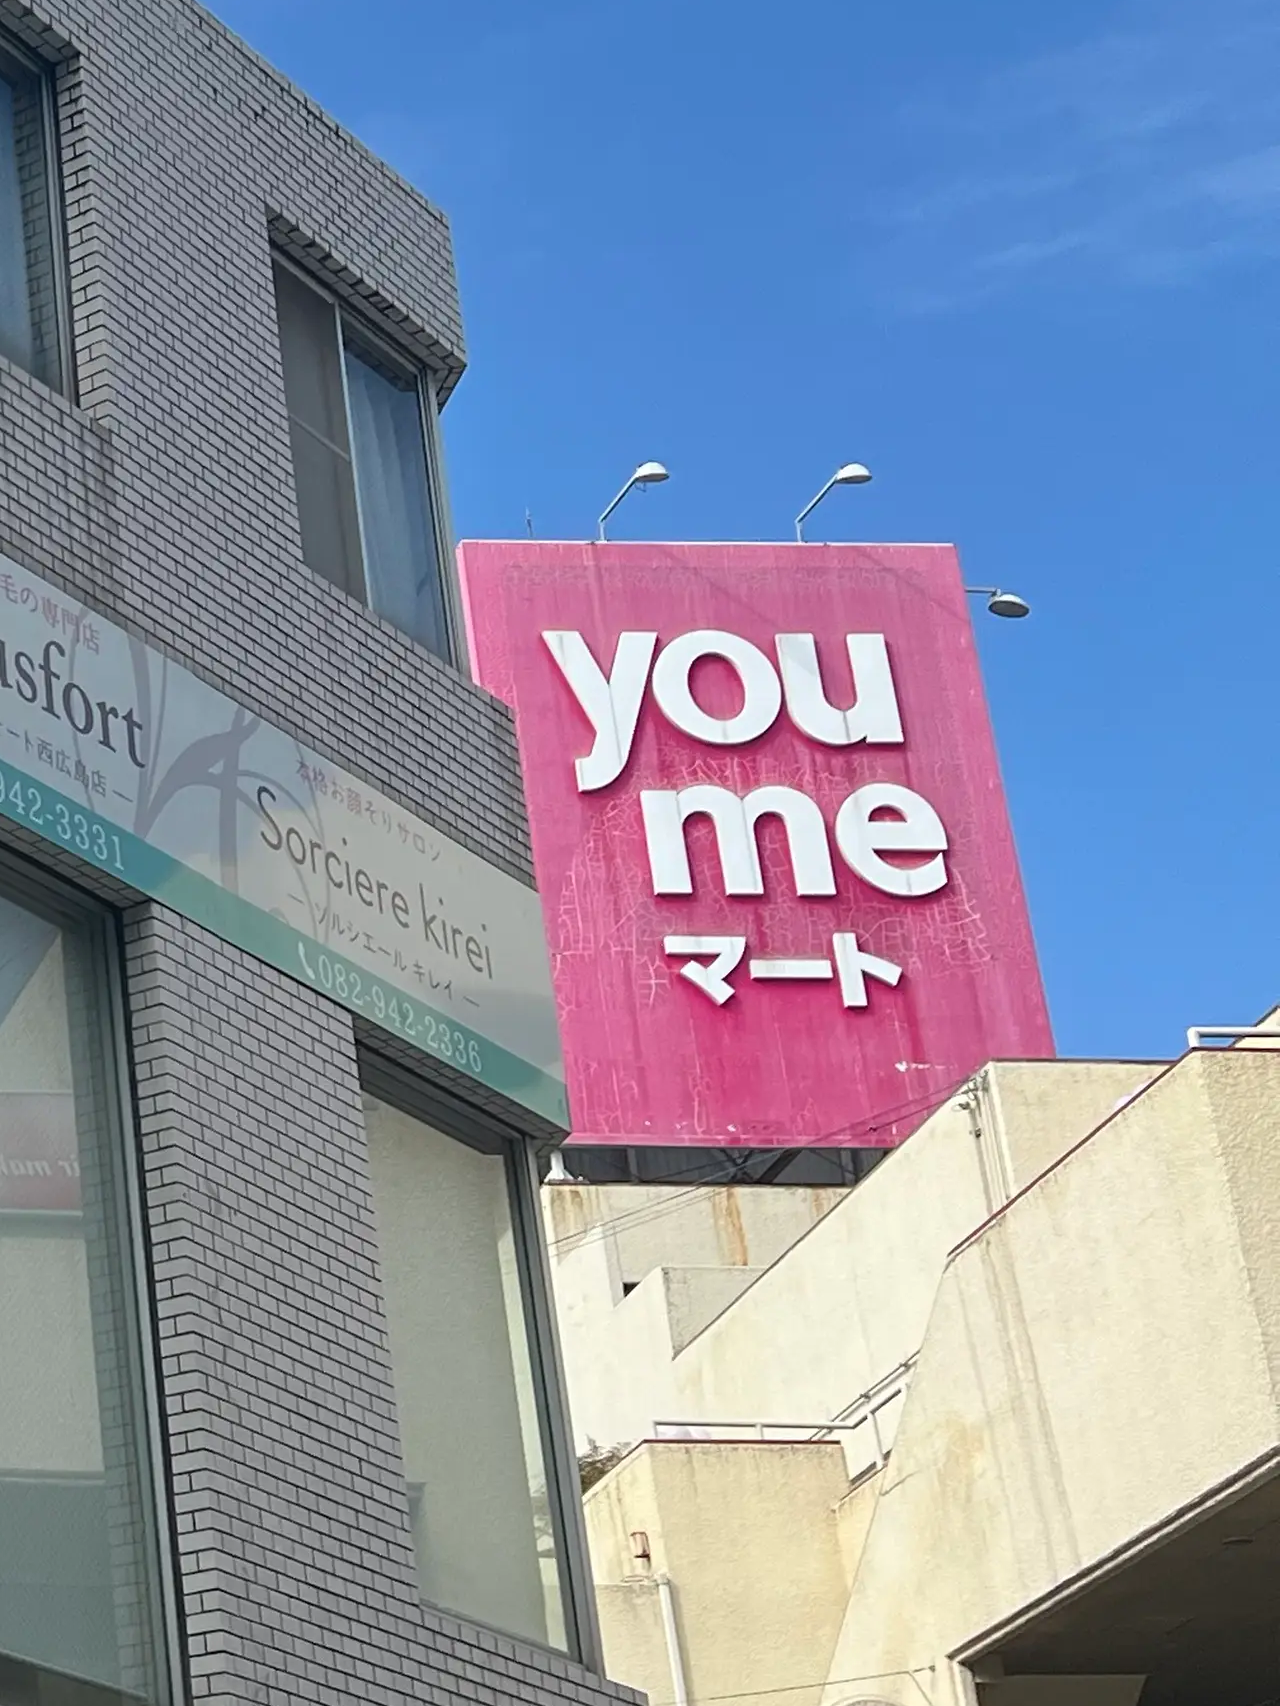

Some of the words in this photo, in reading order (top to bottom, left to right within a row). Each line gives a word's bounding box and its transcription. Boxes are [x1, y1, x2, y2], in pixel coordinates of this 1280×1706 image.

[541, 629, 905, 794] you
[295, 757, 442, 862] 本格お顔そりサロン
[640, 782, 950, 897] me
[256, 784, 410, 930] Sorciere
[418, 882, 494, 980] kirei
[313, 901, 408, 975] ソルシエール
[410, 960, 458, 1001] キレイ
[663, 931, 904, 1009] マート
[316, 951, 483, 1074] 082-942-2336
